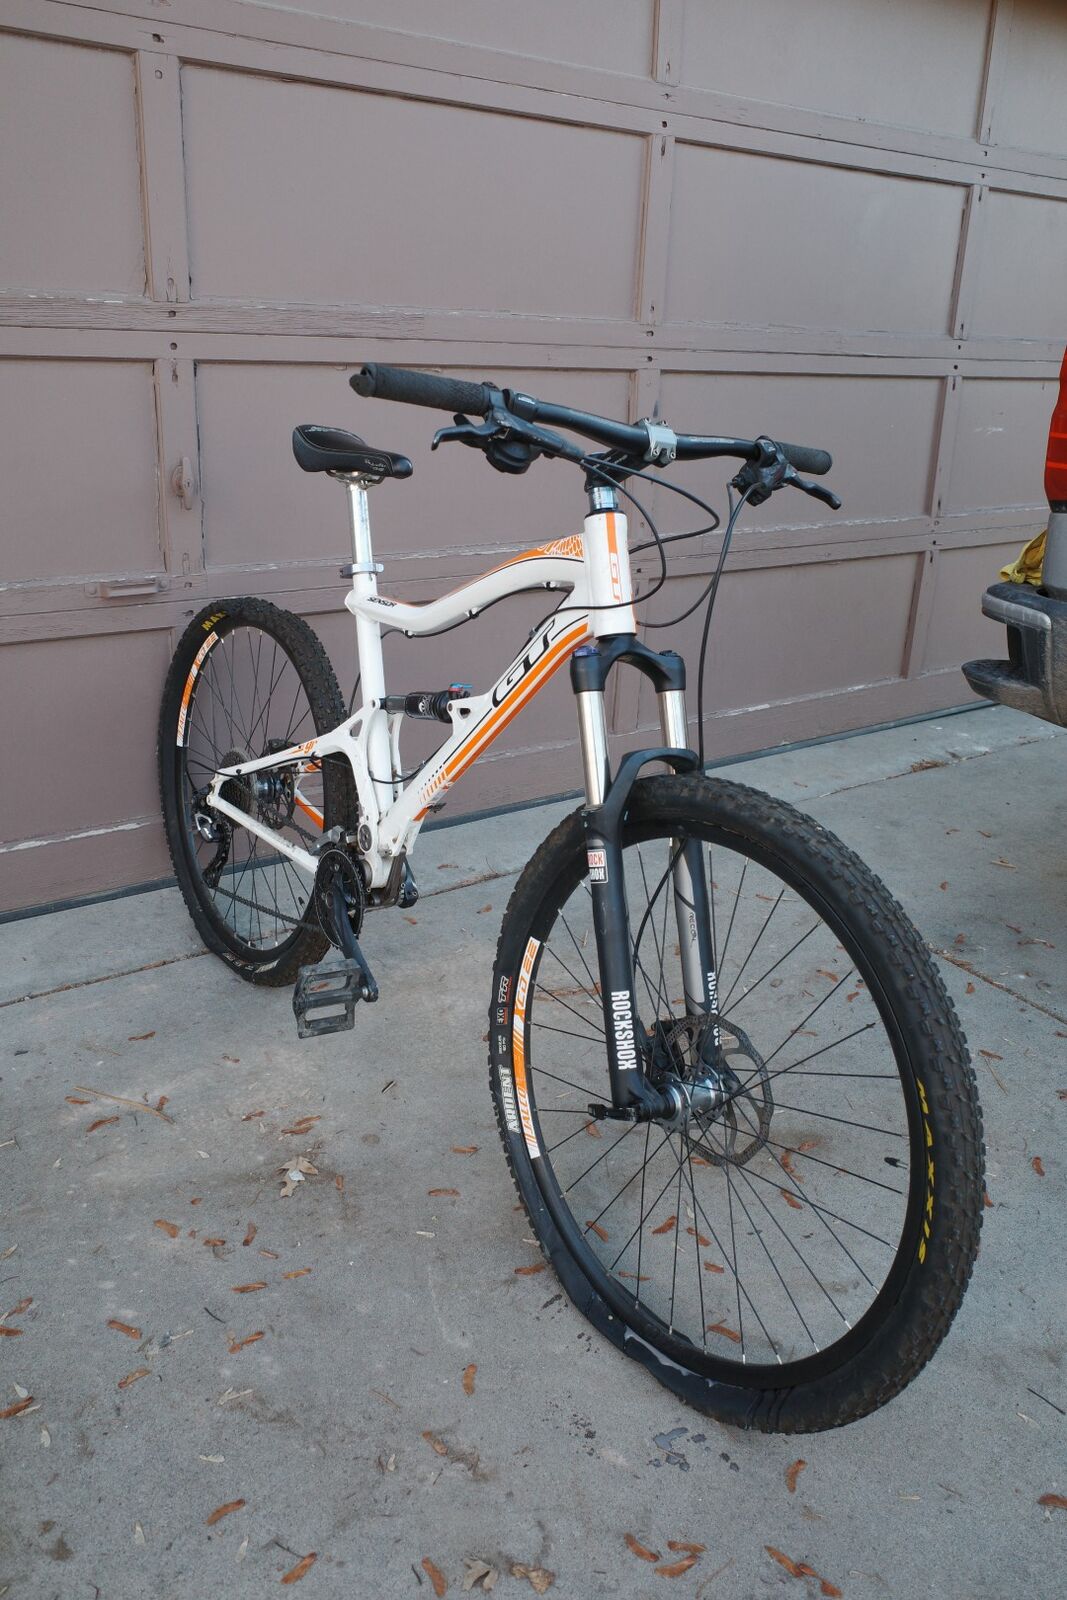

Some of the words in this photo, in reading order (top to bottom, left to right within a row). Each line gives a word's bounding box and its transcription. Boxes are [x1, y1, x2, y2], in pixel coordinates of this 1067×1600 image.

[367, 597, 397, 608] SENSOR
[493, 618, 556, 707] GT
[611, 991, 637, 1070] ROCKSHOX
[499, 1066, 519, 1132] ARDENT
[917, 1079, 934, 1264] MAXXIS
